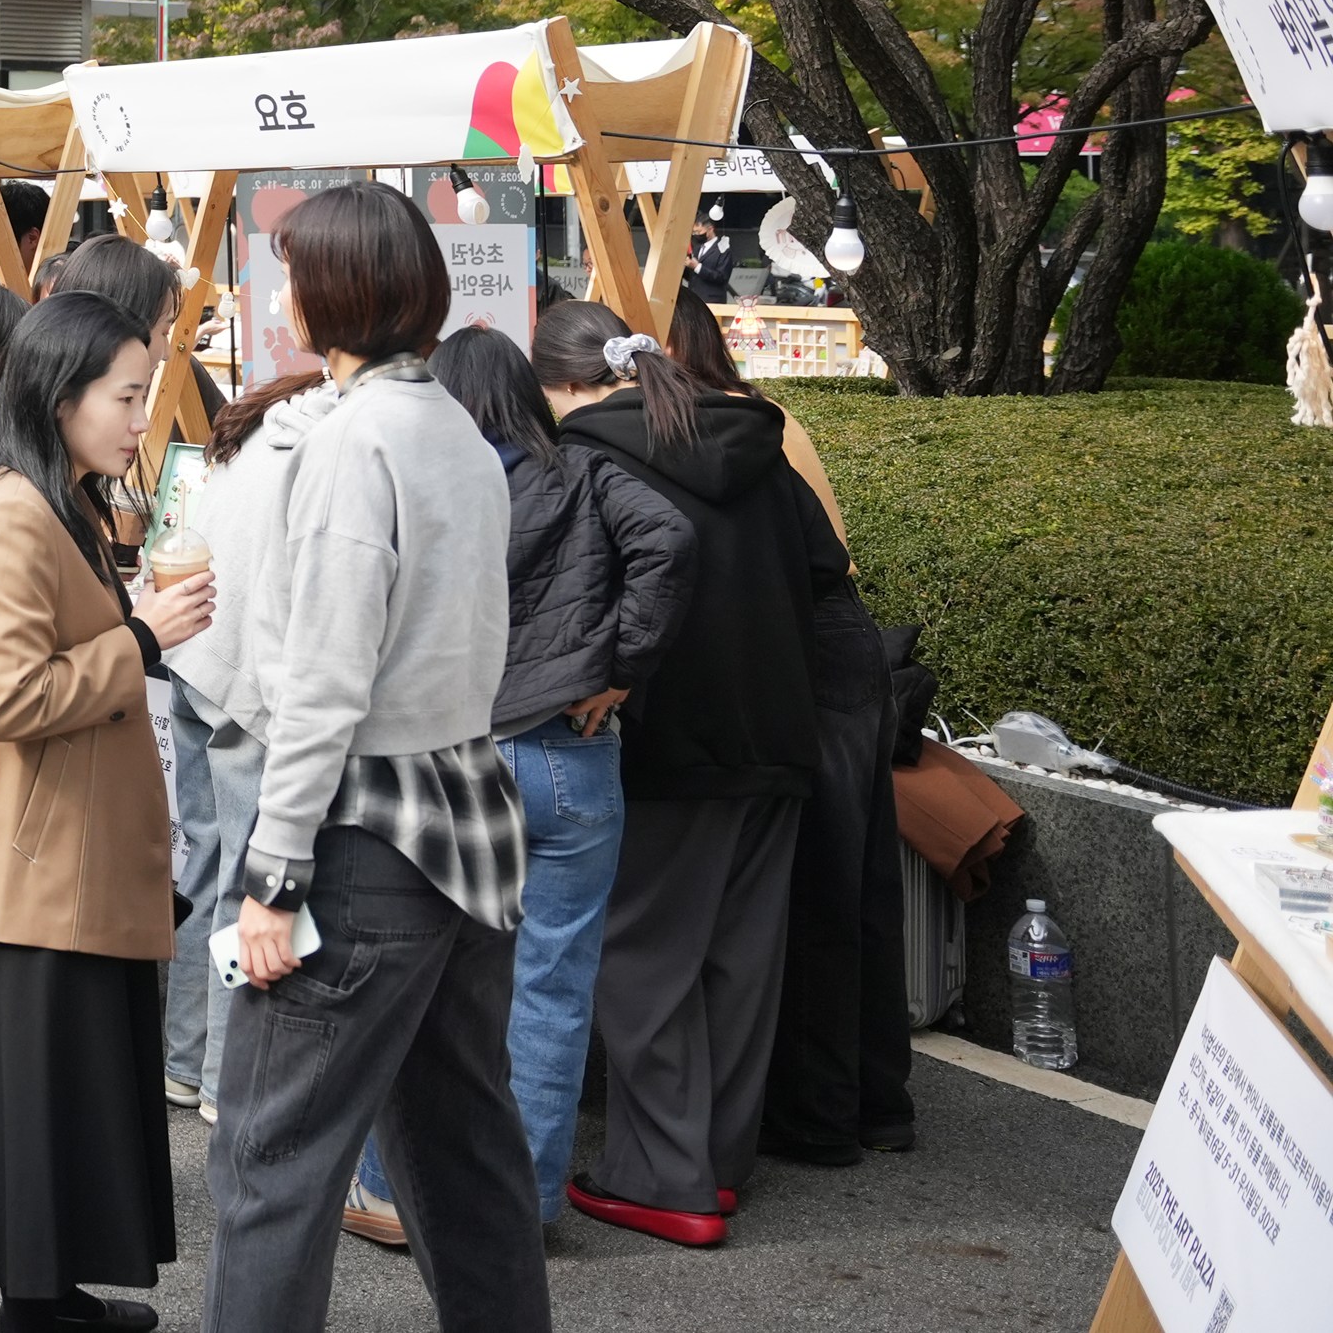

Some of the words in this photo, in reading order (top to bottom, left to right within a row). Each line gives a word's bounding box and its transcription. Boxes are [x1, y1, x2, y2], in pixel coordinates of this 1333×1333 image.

[255, 90, 315, 131] 요호
[1144, 1160, 1165, 1199] 2025
[1160, 1184, 1179, 1224] THE
[1174, 1212, 1194, 1249] ART
[1188, 1235, 1216, 1294] PLAZA
